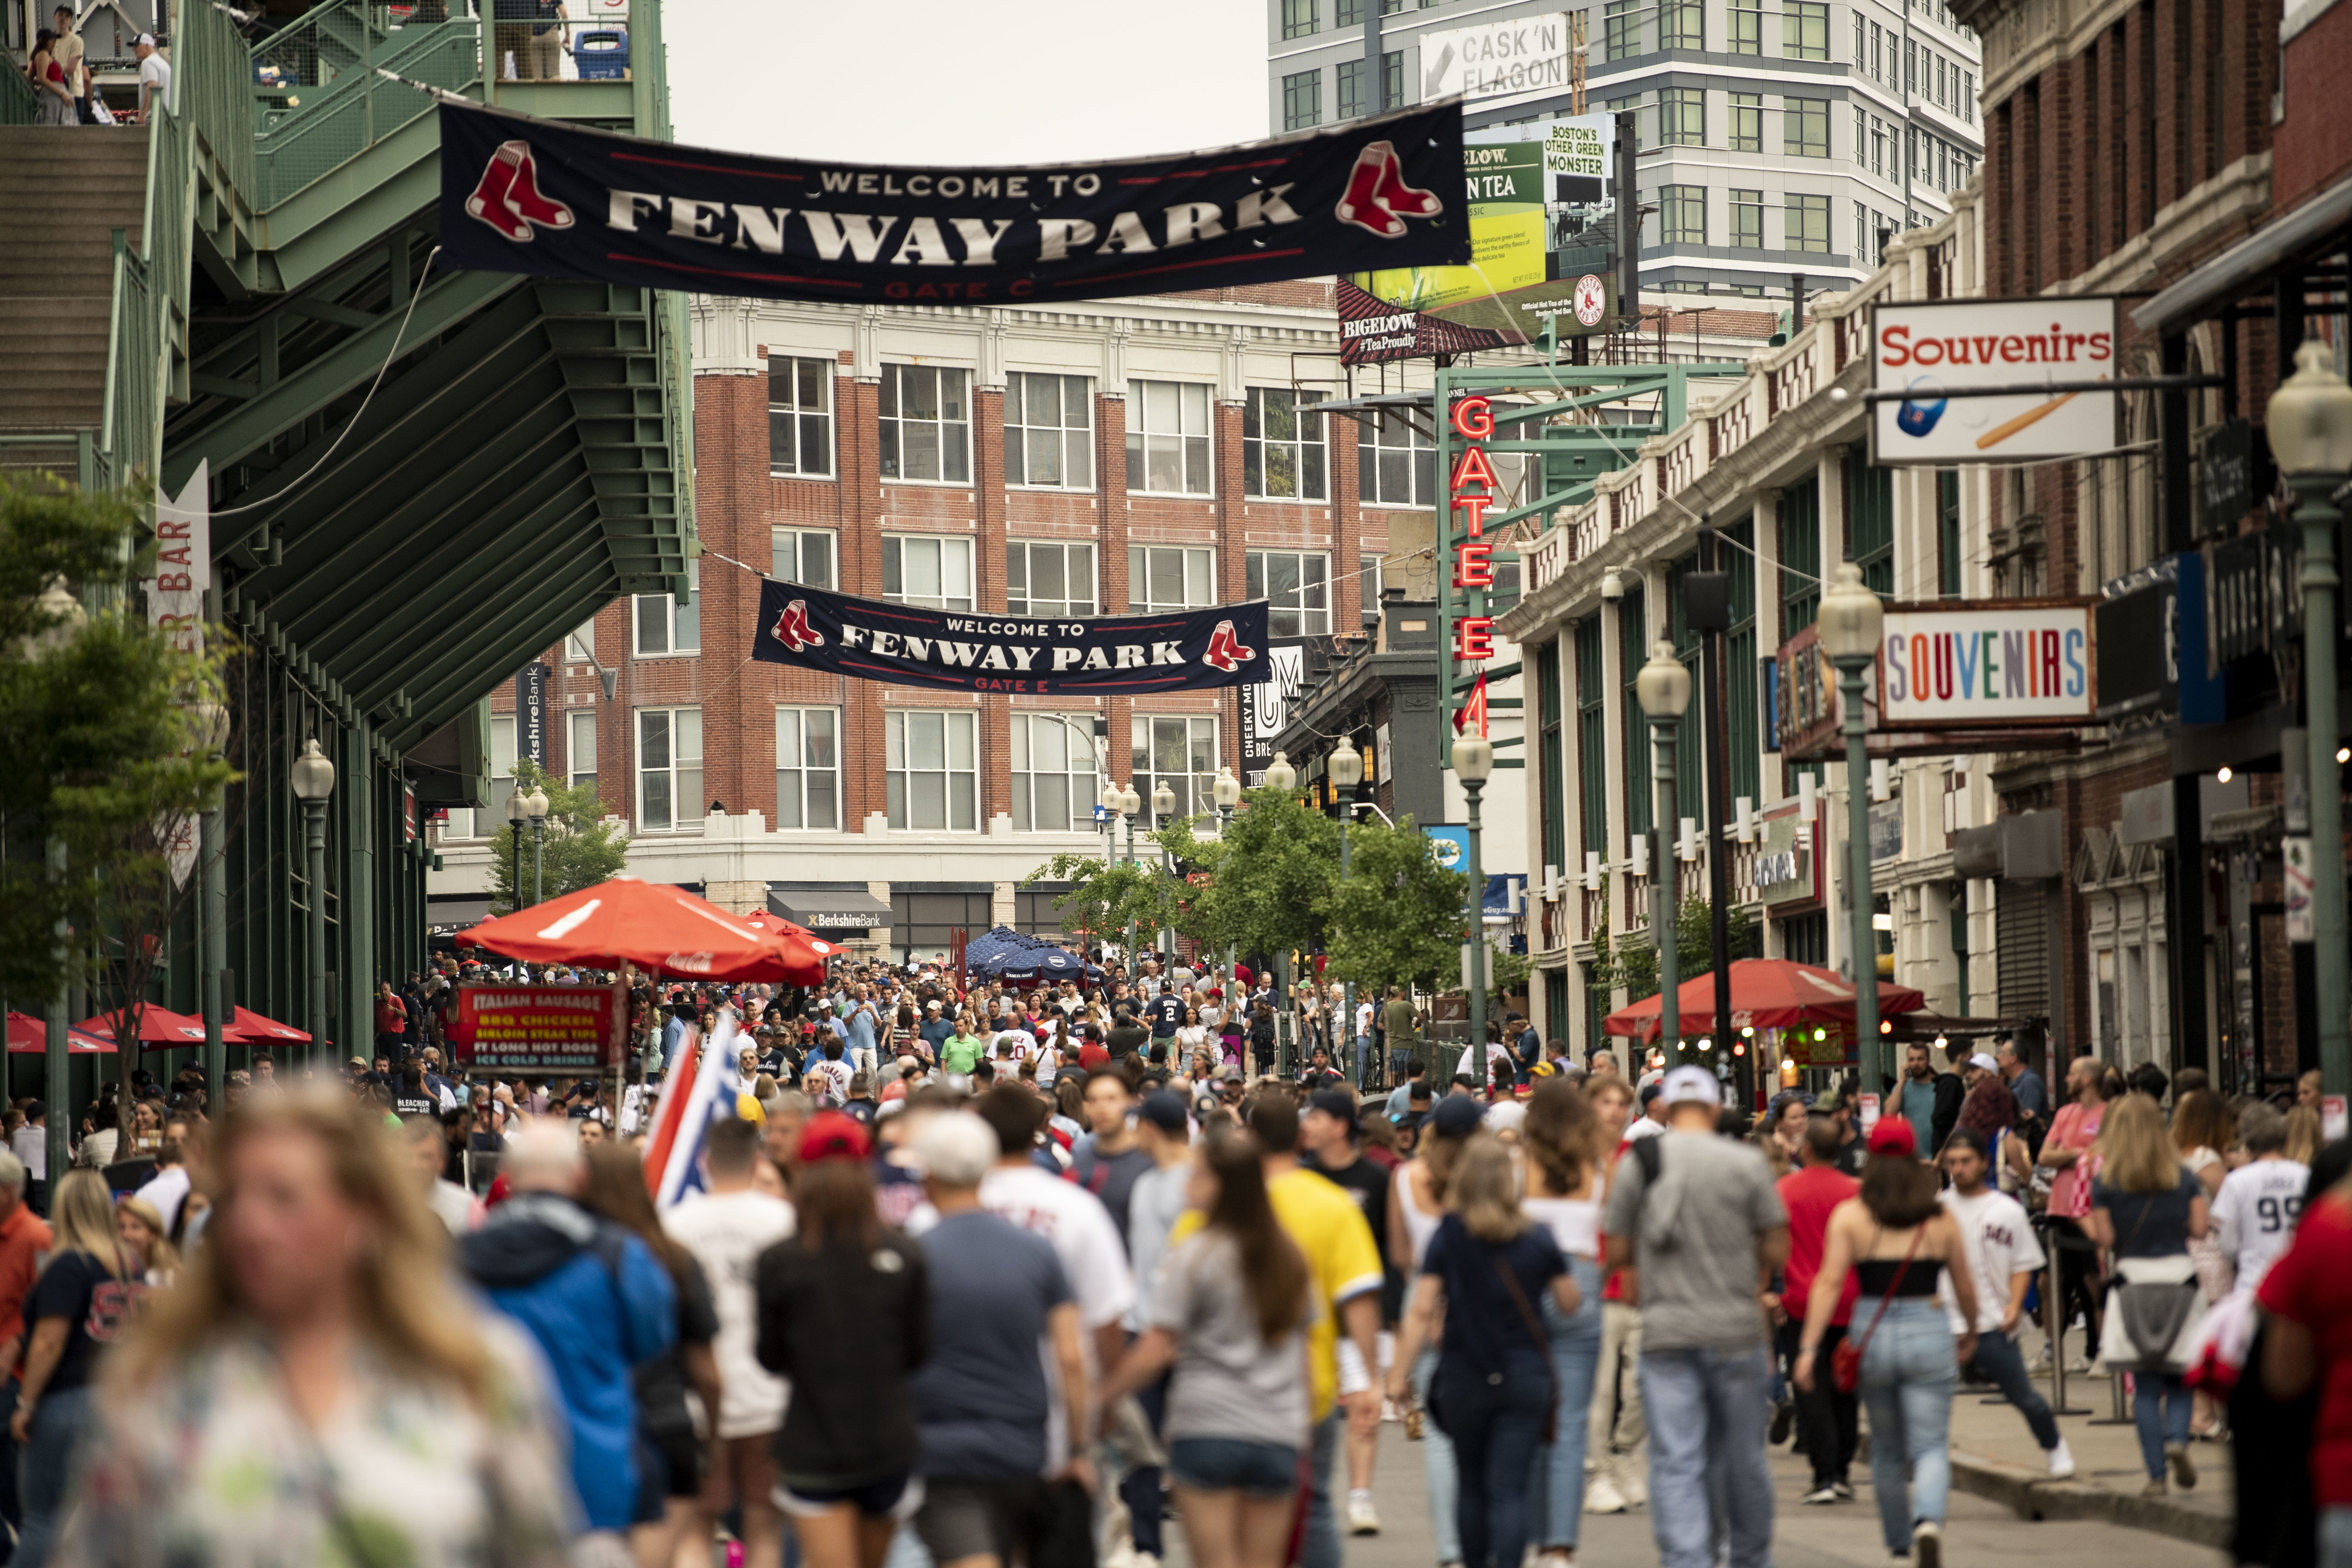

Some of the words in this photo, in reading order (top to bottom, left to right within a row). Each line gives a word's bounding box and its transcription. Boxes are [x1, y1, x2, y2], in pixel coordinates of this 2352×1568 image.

[1462, 28, 1528, 63] CASK
[1534, 24, 1556, 52] 'N
[1463, 56, 1561, 95] FLAGON
[1552, 125, 1597, 141] BOSTON'S
[1464, 148, 1506, 165] ELOW
[1545, 139, 1573, 154] OTHER
[1576, 142, 1605, 156] GREEN
[1546, 155, 1603, 175] MONSTER
[821, 170, 1029, 199] WELCOME
[1047, 173, 1102, 198] TO
[1482, 174, 1516, 198] TEA
[1469, 206, 1485, 216] SSIC
[605, 188, 1014, 266] FENWAY
[1037, 182, 1304, 263] PARK
[1481, 236, 1501, 245] signature
[884, 281, 989, 299] GATE
[1008, 278, 1034, 297] C
[1578, 278, 1601, 294] BOSTON
[1521, 302, 1539, 310] Official
[1578, 307, 1589, 322] RED
[1591, 306, 1602, 321] SOX
[1343, 312, 1416, 339] BIGELOW
[1359, 333, 1416, 353] #TeaProudly
[1881, 322, 2112, 367] Souvenirs
[1451, 394, 1497, 587] GATE
[157, 520, 192, 591] BAR
[946, 618, 1050, 638] WELCOME
[1058, 623, 1085, 638] TO
[840, 623, 1041, 671] FENWAY
[1052, 640, 1186, 671] PARK
[1458, 616, 1495, 660] E
[1887, 628, 2084, 703] SOUVENIRS
[975, 676, 1027, 693] GATE
[1037, 679, 1049, 693] E
[1242, 684, 1252, 704] MO
[527, 667, 540, 767] rkshireBank
[1244, 707, 1254, 758] CHEEKY
[1255, 742, 1271, 757] BRE
[1250, 772, 1267, 786] TURN
[818, 912, 881, 927] BerkshireBank
[472, 994, 532, 1011] ITALIAN
[534, 994, 602, 1012] SAUSAGE
[478, 1014, 516, 1027] BBQ
[519, 1014, 596, 1027] CHICKEN
[1165, 1007, 1175, 1022] 2
[475, 1029, 527, 1040] SIRLOIN
[529, 1029, 569, 1040] STEAK
[570, 1029, 599, 1040] TIPS
[1011, 1035, 1025, 1044] DICK
[473, 1041, 489, 1053] FT
[490, 1041, 529, 1053] LONG
[530, 1041, 559, 1053] HOT
[560, 1041, 599, 1053] DOGS
[475, 1054, 499, 1065] ICE
[500, 1054, 539, 1065] COLD
[541, 1054, 597, 1065] DRINKS
[756, 1060, 778, 1071] ankees
[819, 1065, 843, 1085] DONALD
[397, 1099, 430, 1108] BLEACHER
[2258, 1196, 2303, 1233] 99
